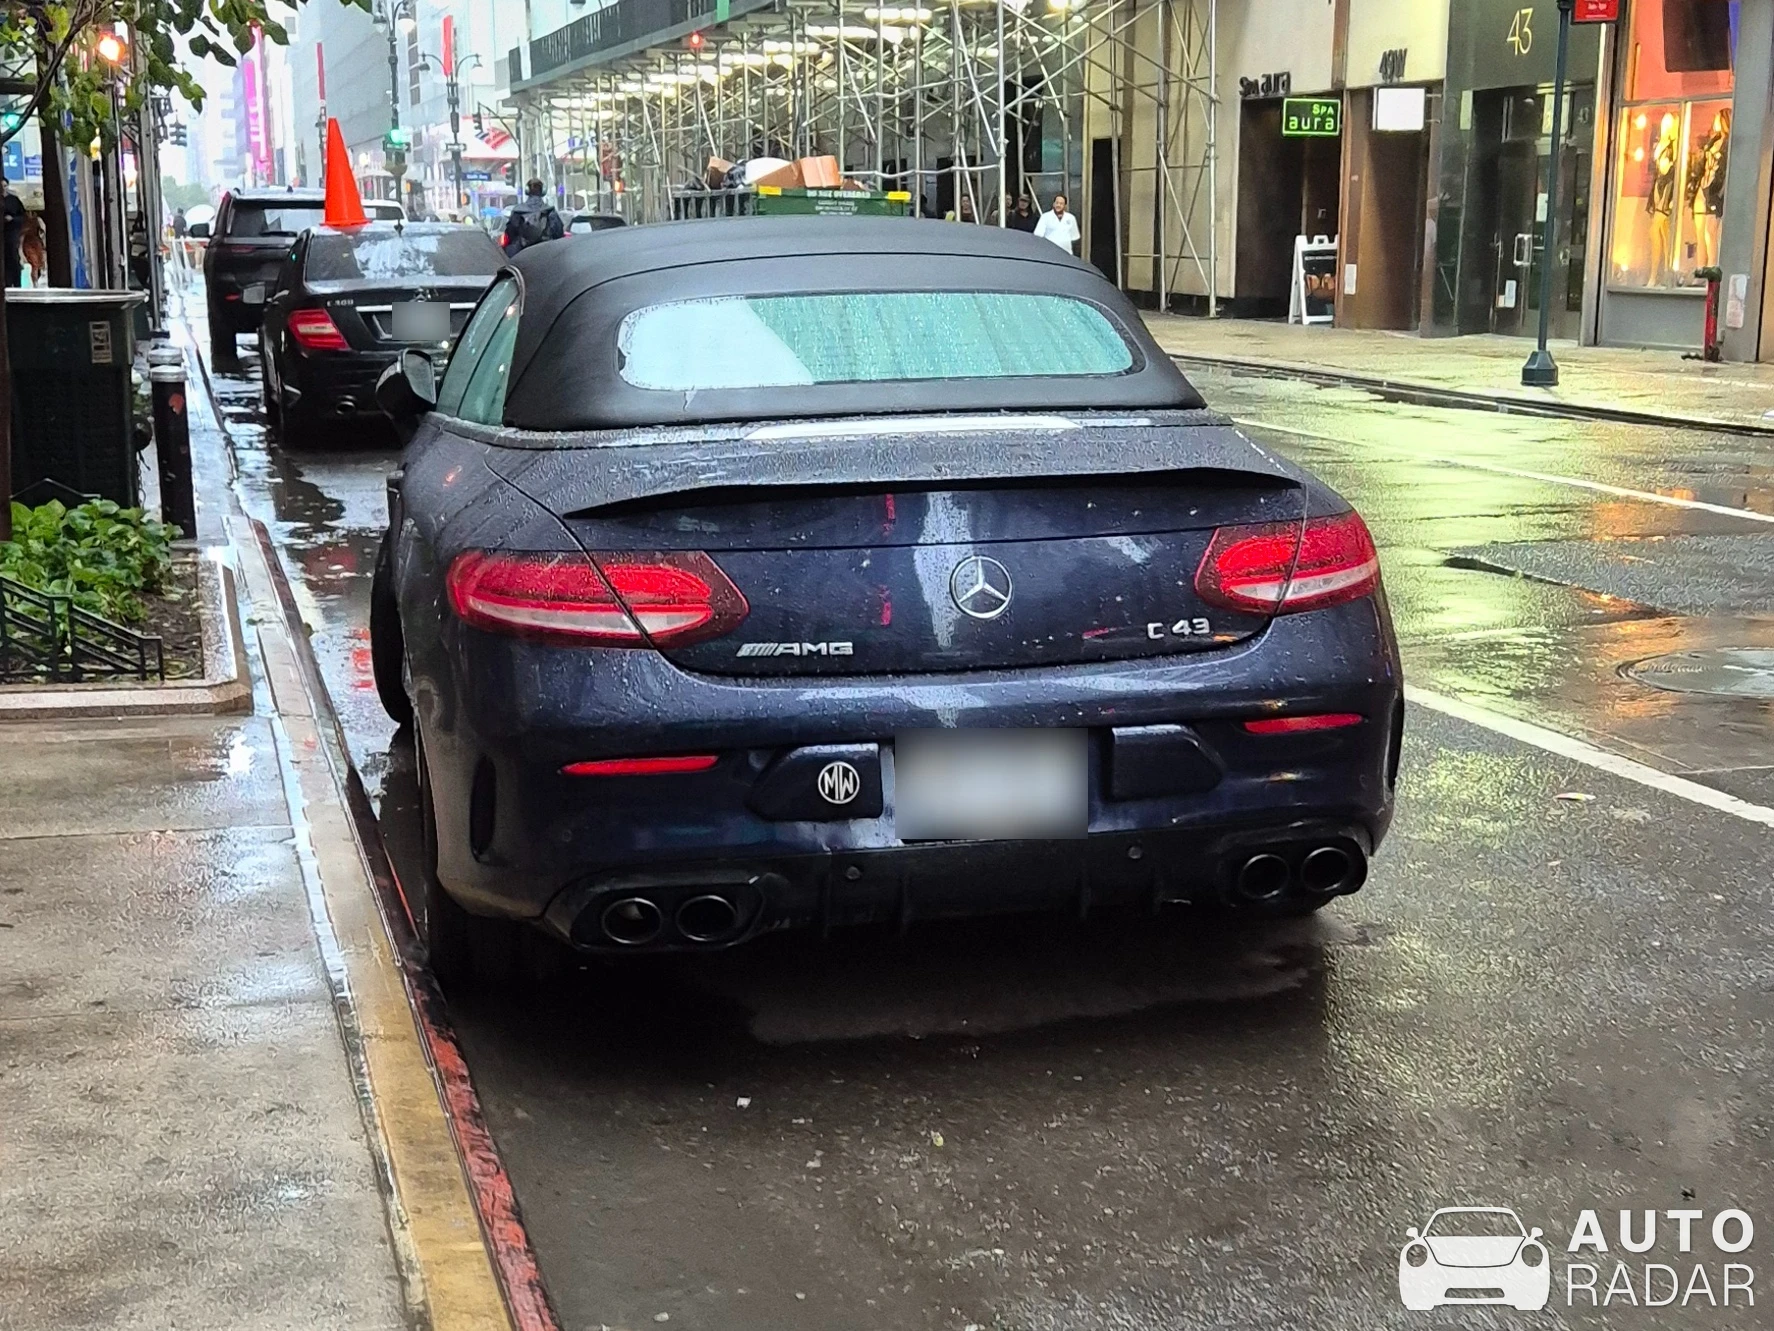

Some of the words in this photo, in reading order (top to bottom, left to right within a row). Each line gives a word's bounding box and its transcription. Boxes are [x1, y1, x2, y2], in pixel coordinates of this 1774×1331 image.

[1506, 8, 1533, 56] 43
[1289, 116, 1334, 131] aura
[1147, 622, 1164, 639] C
[1172, 618, 1210, 635] 43
[774, 642, 853, 656] AMG
[824, 764, 854, 801] MW
